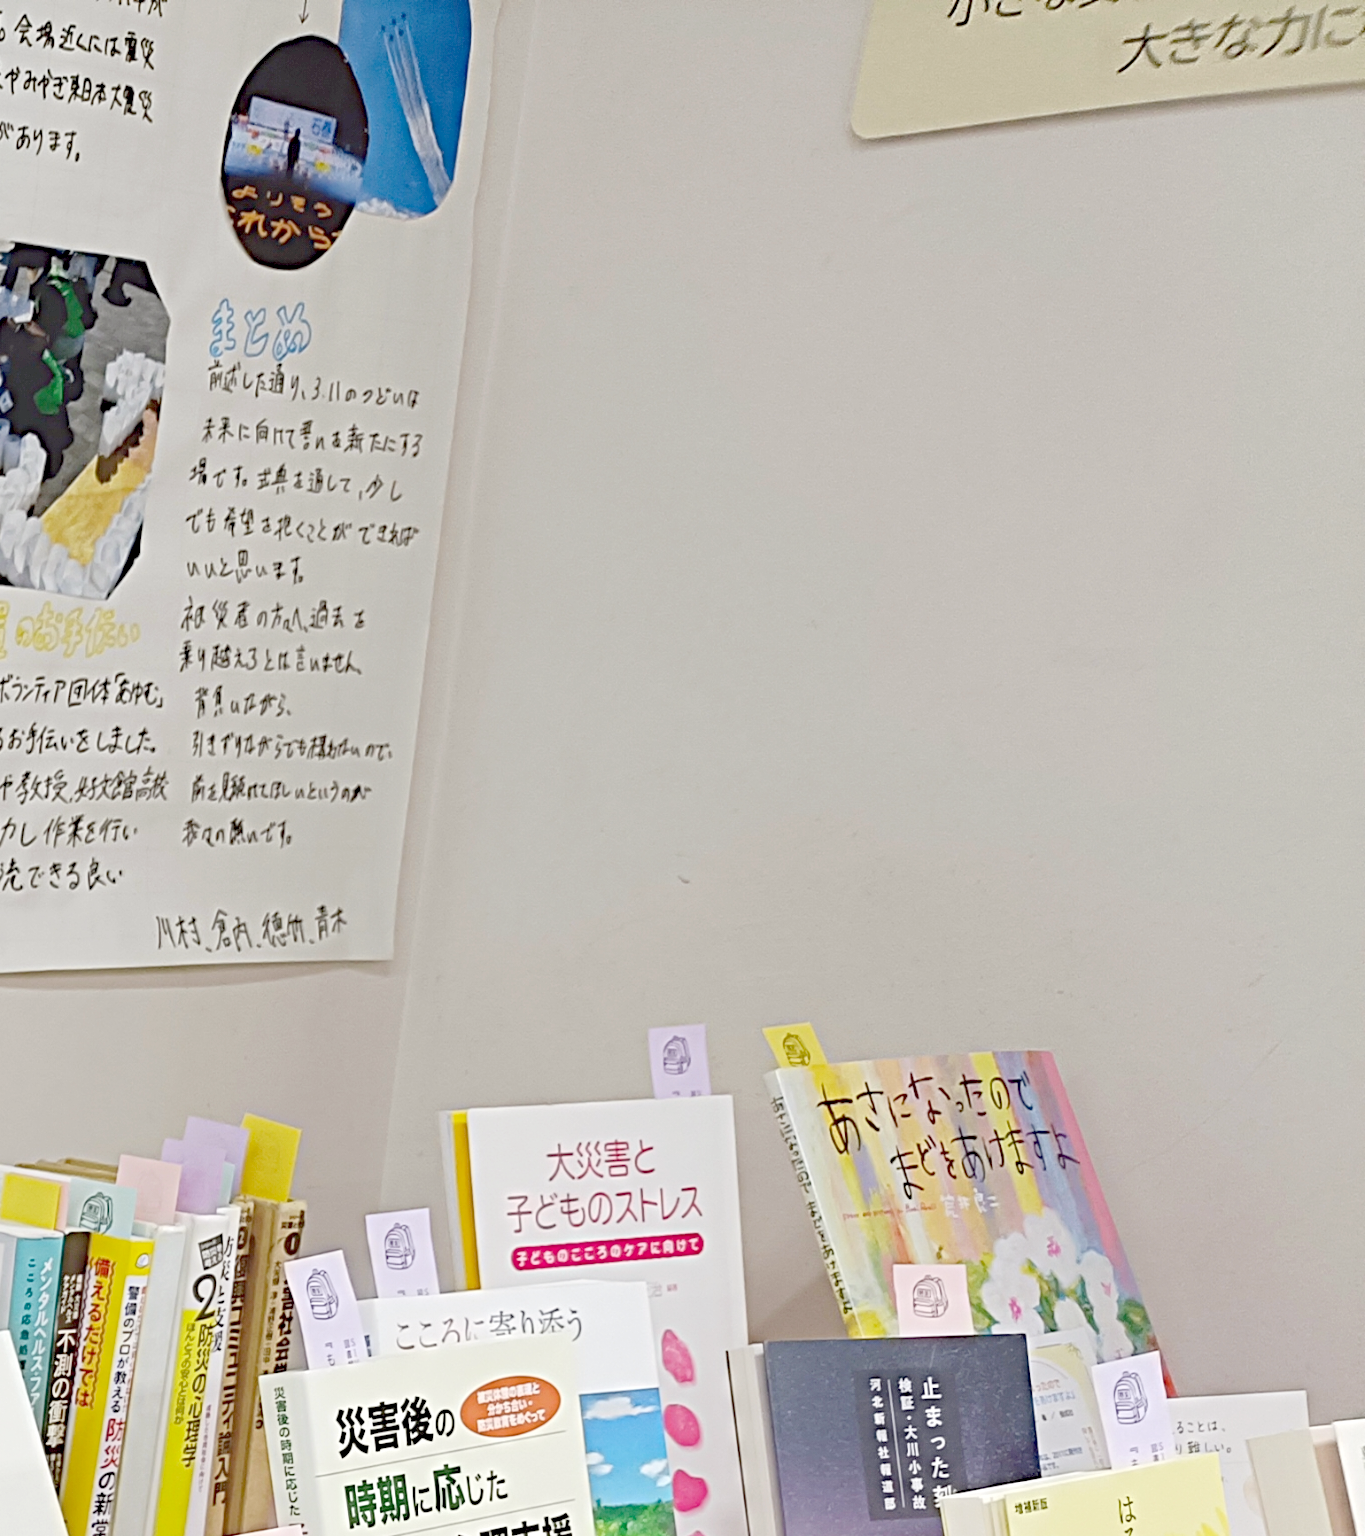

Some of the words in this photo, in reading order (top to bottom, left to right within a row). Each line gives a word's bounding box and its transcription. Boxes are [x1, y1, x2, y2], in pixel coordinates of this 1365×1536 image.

[209, 298, 312, 362] まとめ
[817, 1070, 1036, 1156] あさになったので
[546, 1138, 656, 1182] 大災害と
[890, 1120, 1081, 1200] まどをあけますよ
[506, 1186, 704, 1234] 子どものストレス
[515, 1236, 701, 1268] 子どものこころのケアに向けて
[74, 1257, 111, 1408] 備えるだけでは
[192, 1274, 218, 1322] 2
[45, 1329, 76, 1448] 不測の衝撃
[273, 1387, 301, 1517] 災害後の時期に応じた
[335, 1396, 456, 1459] 災害後の
[868, 1376, 897, 1512] 河北新報社報道部
[898, 1377, 927, 1511] 検証・大川小事故
[344, 1464, 509, 1530] 時期に応じた
